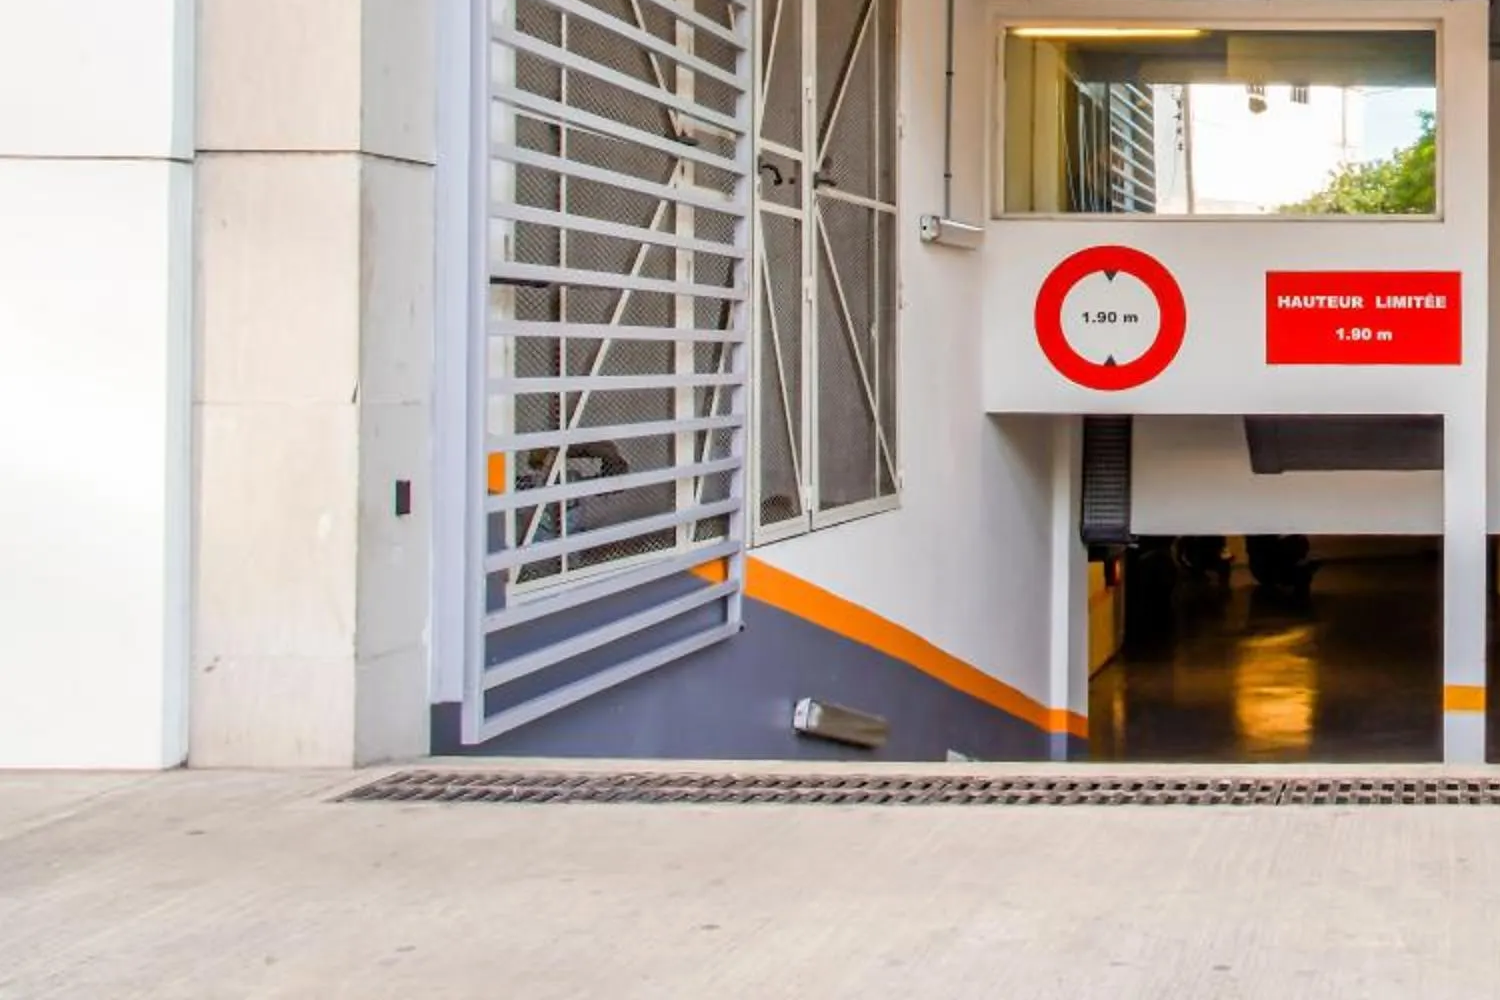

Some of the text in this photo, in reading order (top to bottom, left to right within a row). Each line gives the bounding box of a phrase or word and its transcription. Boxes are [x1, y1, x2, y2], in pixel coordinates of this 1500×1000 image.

[1277, 292, 1448, 309] HAUTEUR LIMITÉE
[1082, 311, 1139, 323] 1.90 m
[1335, 327, 1393, 341] 1.90 m
